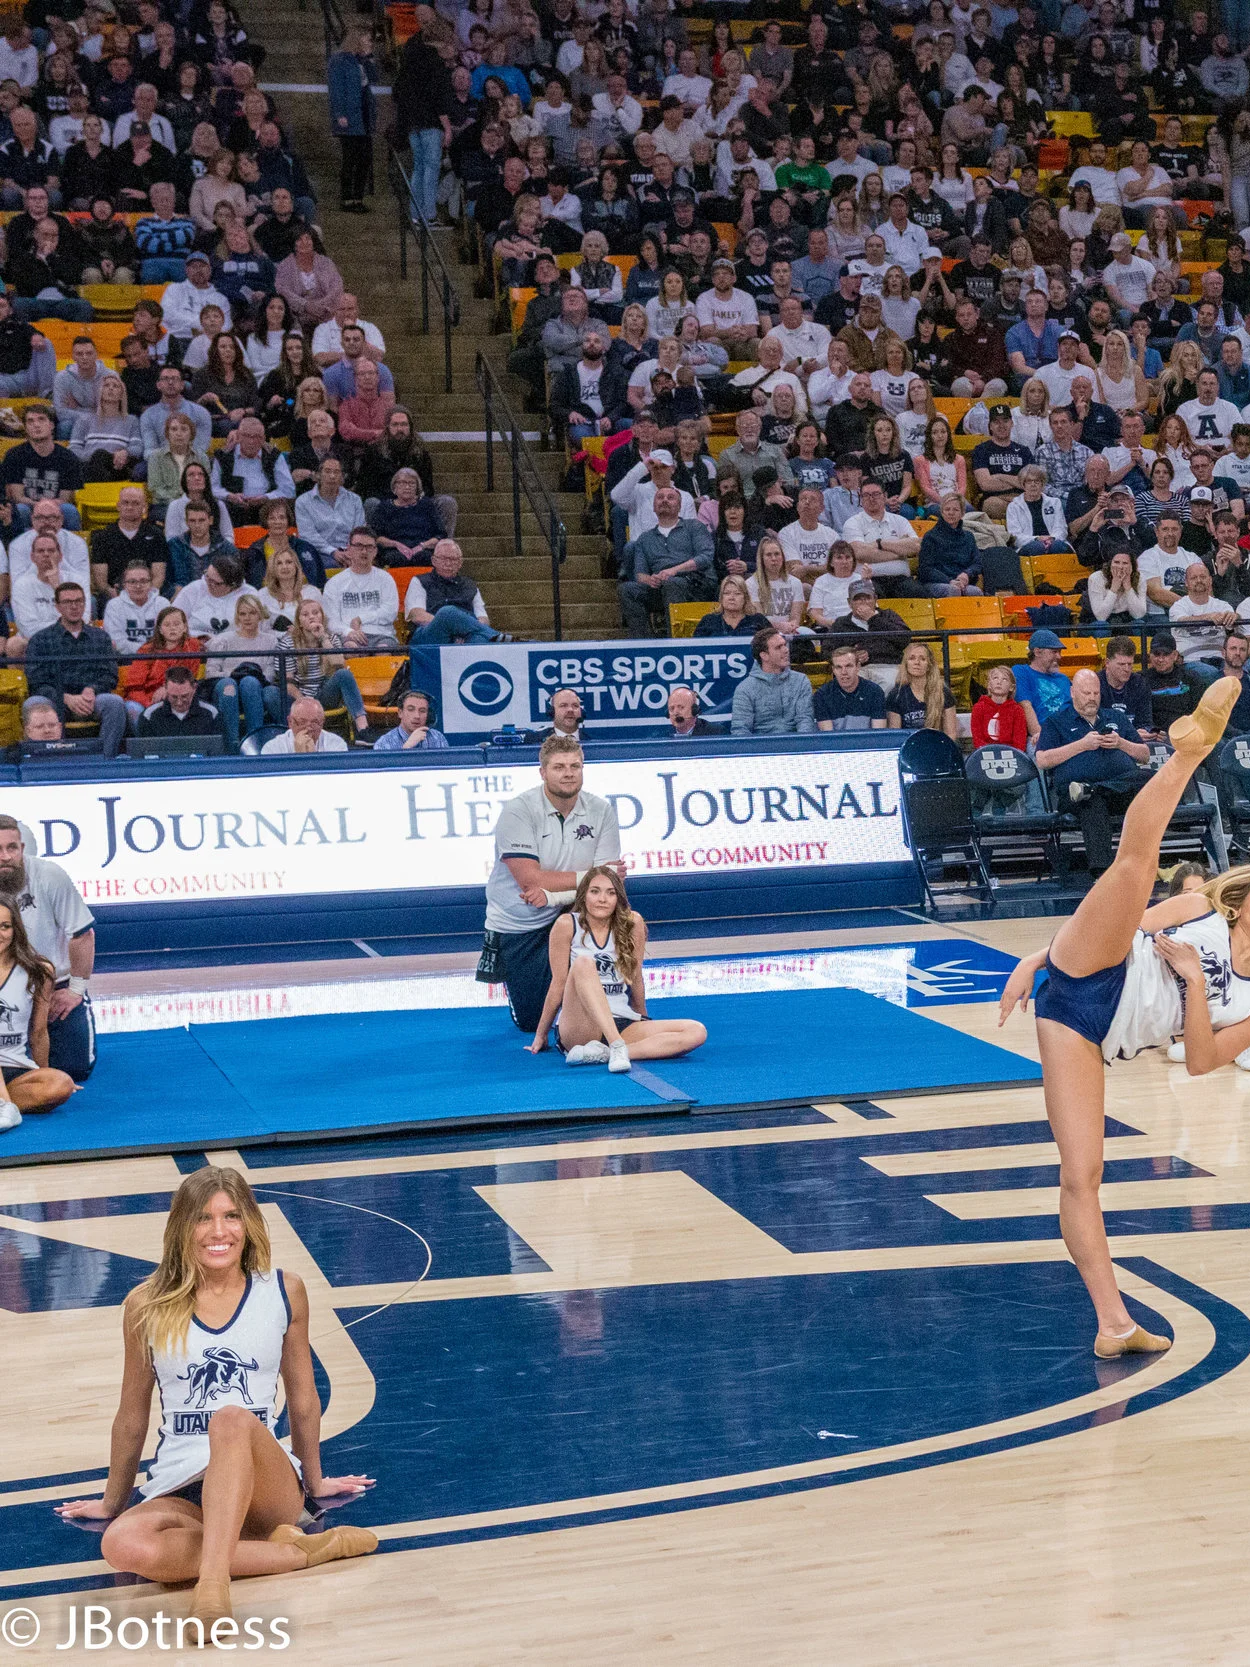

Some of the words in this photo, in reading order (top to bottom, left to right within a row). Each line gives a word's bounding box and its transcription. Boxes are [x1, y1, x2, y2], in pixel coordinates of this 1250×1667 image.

[1195, 414, 1223, 440] A
[536, 657, 604, 685] CBS
[612, 652, 748, 682] SPORTS
[538, 682, 716, 714] NTWOK
[468, 775, 513, 793] THE
[657, 772, 898, 841] JOURNAL
[98, 796, 367, 868] JOURNAL
[642, 850, 686, 869] THE
[691, 842, 828, 867] COMMUNITY
[78, 878, 127, 898] THE
[133, 871, 287, 897] COMMUNITY
[0, 1034, 22, 1047] TATE
